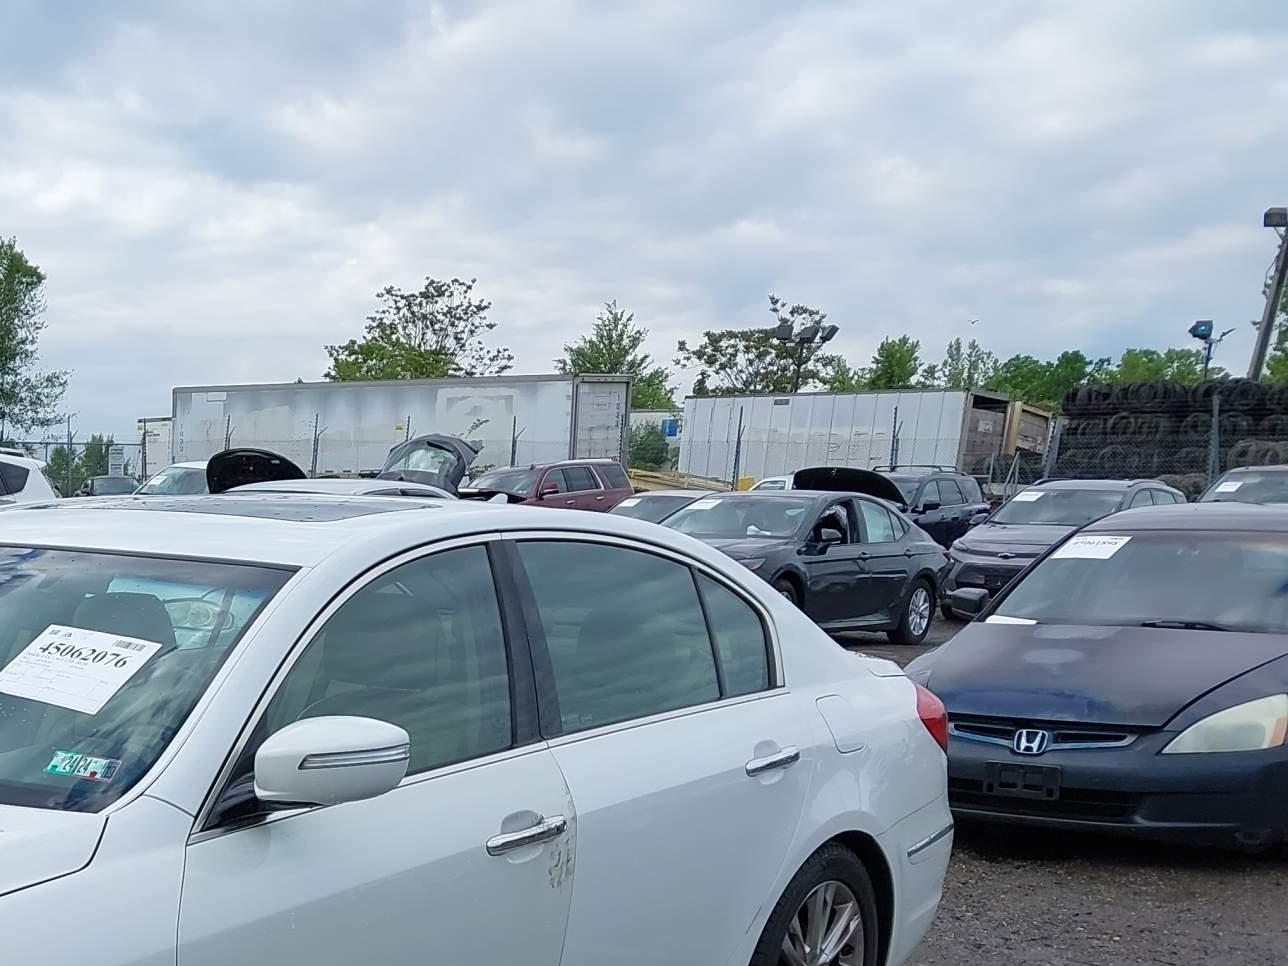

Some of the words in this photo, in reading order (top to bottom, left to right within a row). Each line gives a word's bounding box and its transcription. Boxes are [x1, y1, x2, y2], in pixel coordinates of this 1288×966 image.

[39, 641, 133, 669] 45062076
[63, 755, 78, 770] 24
[77, 758, 93, 773] 24
